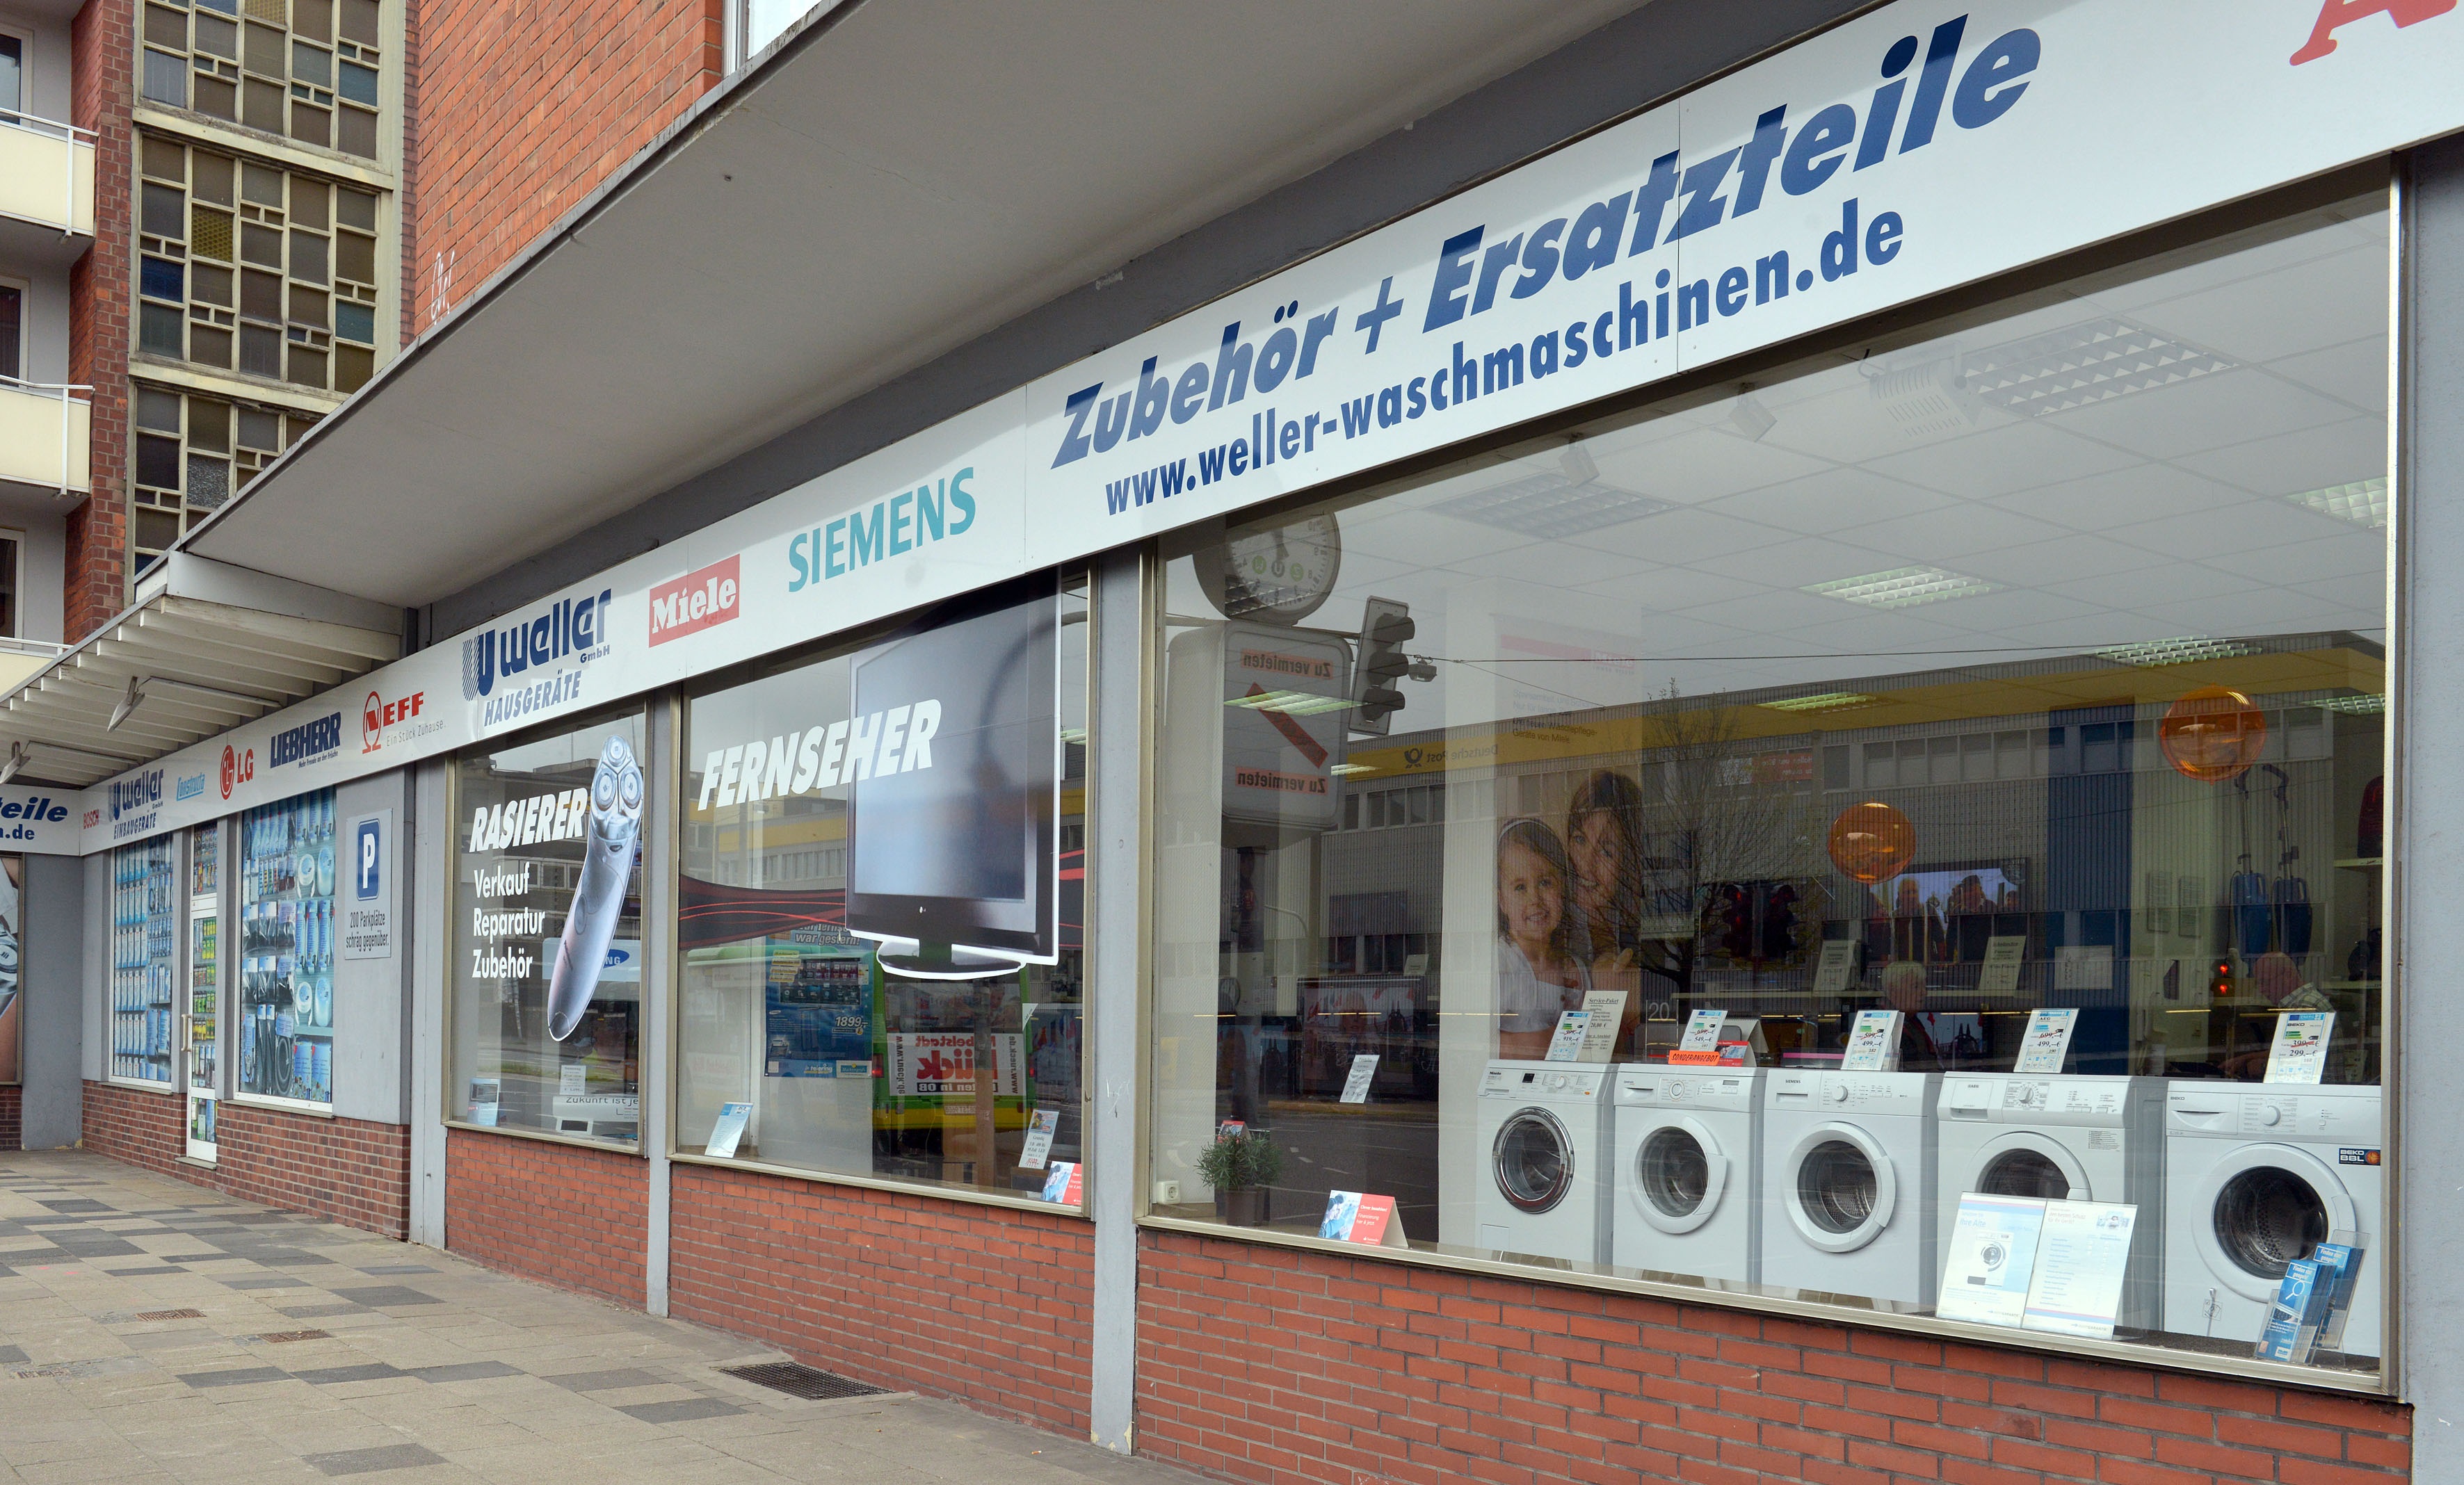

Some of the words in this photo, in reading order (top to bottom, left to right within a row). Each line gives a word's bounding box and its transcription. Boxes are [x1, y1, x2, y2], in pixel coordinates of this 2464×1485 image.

[1051, 299, 1337, 470] Zubehör
[1354, 276, 1404, 355] +
[1422, 13, 2041, 334] Ersatzteile
[1106, 197, 1904, 515] www.weller-waschmaschinen.de
[789, 466, 976, 593] SIEMENS
[652, 576, 736, 633] Miele
[580, 644, 610, 663] GmbH
[366, 690, 424, 733] NEFF
[485, 669, 582, 727] HAUSGERÄTE
[271, 711, 341, 769] LIEBHERR
[387, 735, 397, 747] Ein
[398, 729, 416, 743] Stück
[698, 699, 942, 812] FERNSEHER
[237, 748, 254, 784] LG
[177, 772, 205, 801] Constructa
[83, 809, 99, 830] BOSCH
[113, 809, 156, 841] EINBAUGERÄTE
[469, 788, 589, 853] RASIERER
[362, 833, 376, 889] P
[474, 861, 531, 898] Verkauf
[350, 911, 360, 929] 200
[360, 909, 385, 931] Parkplätze
[474, 907, 546, 944] Reparatur
[346, 932, 362, 952] schräg
[363, 930, 389, 952] gegenüber.
[795, 932, 819, 943] war
[819, 934, 861, 946] gestern!
[472, 946, 533, 980] Zubehör
[1670, 1053, 1718, 1063] SONDERANGEBOT
